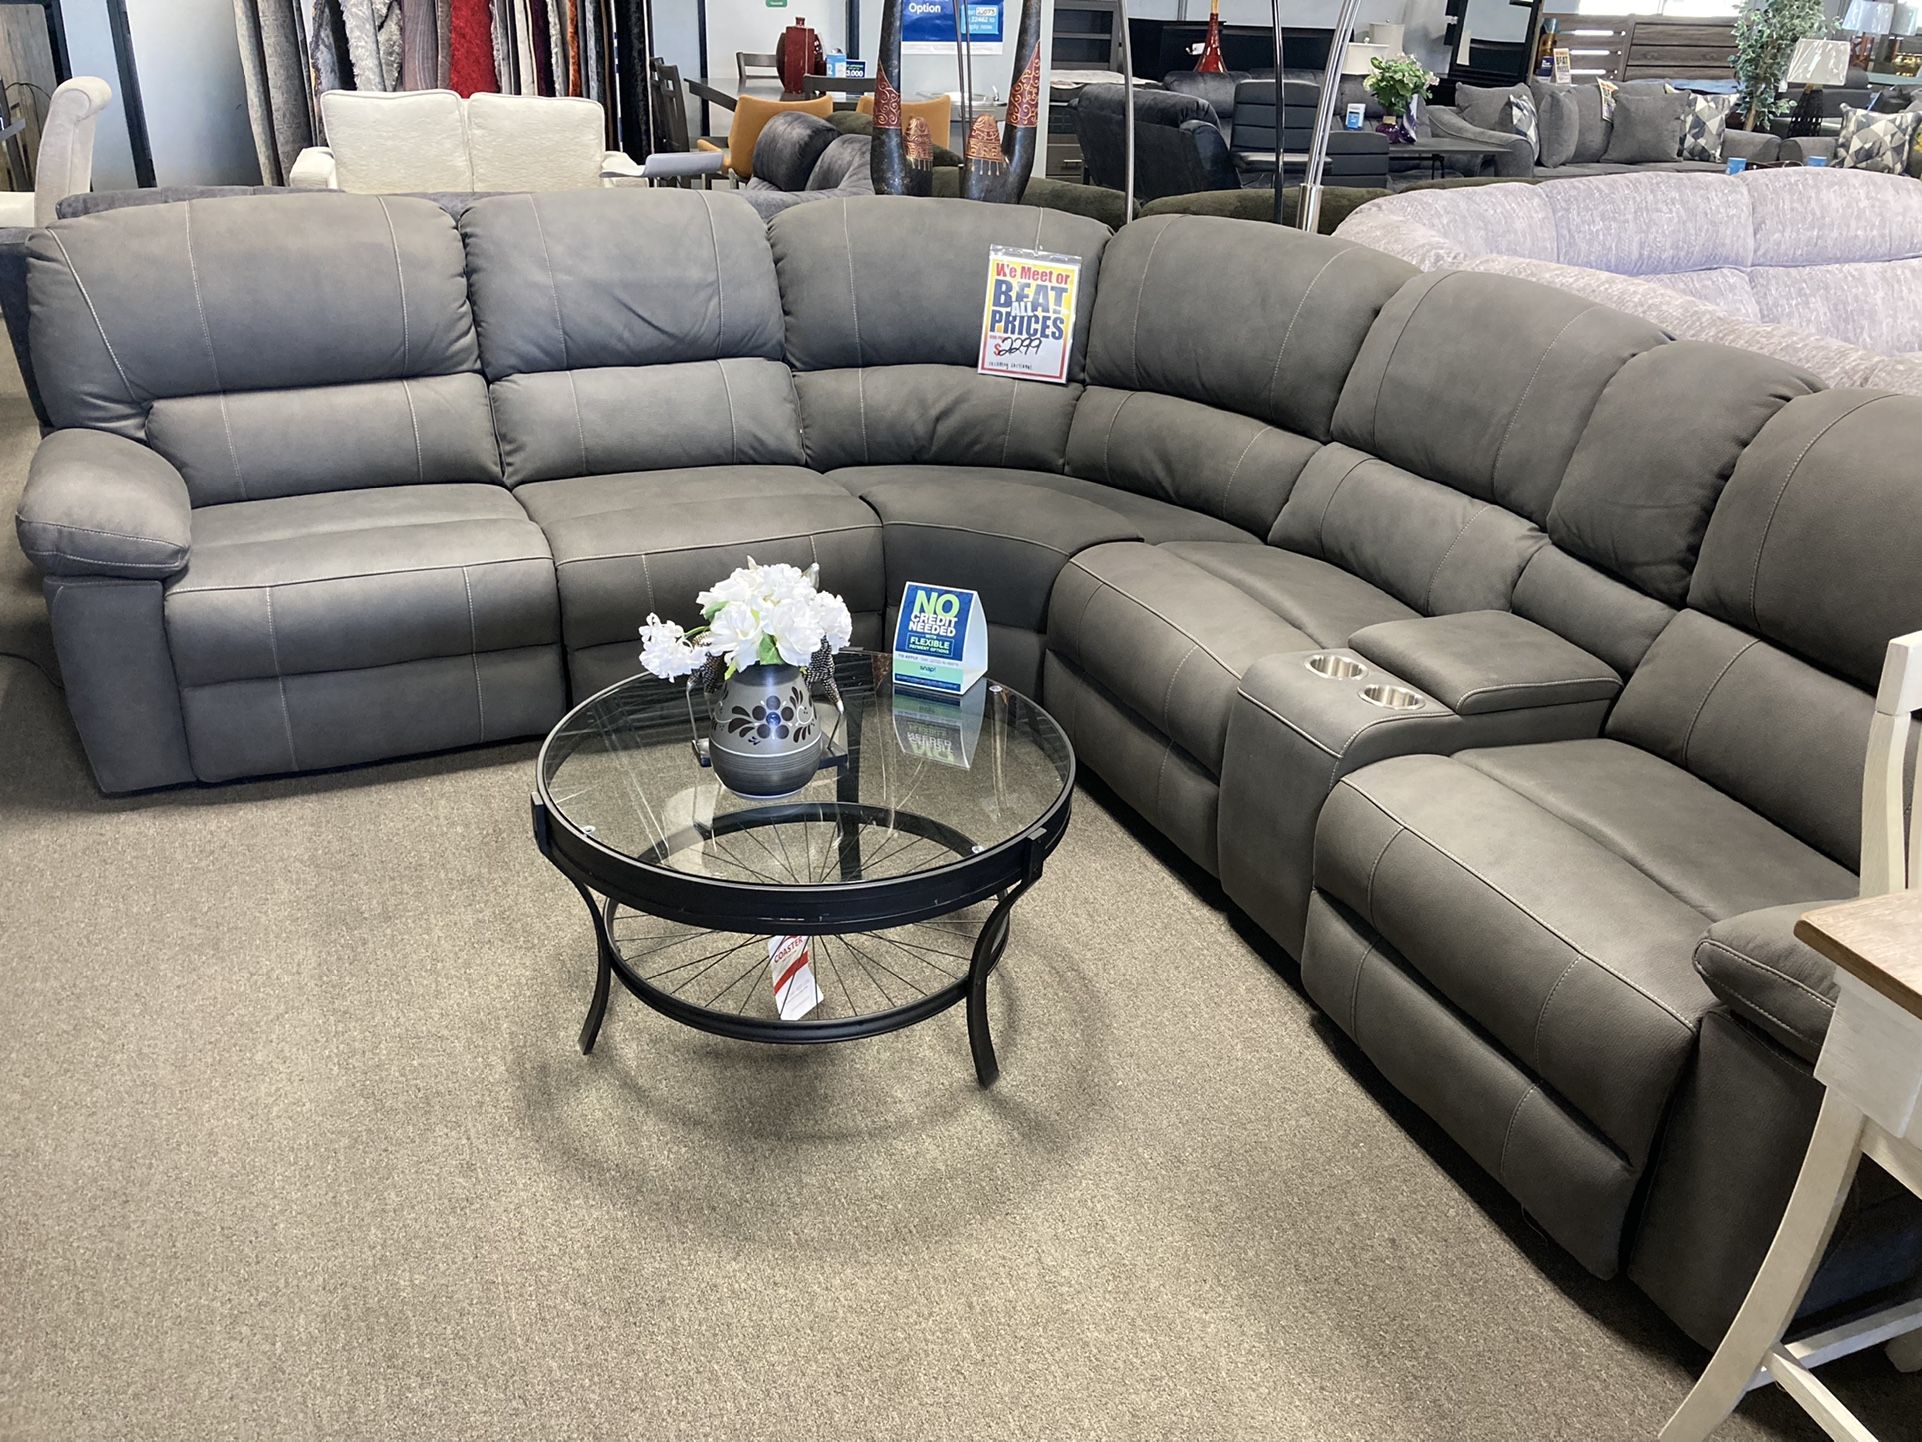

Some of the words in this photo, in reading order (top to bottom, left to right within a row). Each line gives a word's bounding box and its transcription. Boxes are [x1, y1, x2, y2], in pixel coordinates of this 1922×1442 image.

[908, 3, 941, 14] Option
[996, 263, 1017, 278] We
[1020, 266, 1053, 283] Meet
[1056, 273, 1070, 285] or
[992, 278, 1068, 315] BEAT
[1011, 301, 1034, 316] ALL
[989, 309, 1065, 340] PRICES
[912, 590, 960, 617] NO
[908, 621, 956, 637] NEEDED
[911, 612, 958, 628] CREDIT
[910, 636, 950, 650] FLEXIBLE
[774, 936, 803, 963] COASTER
